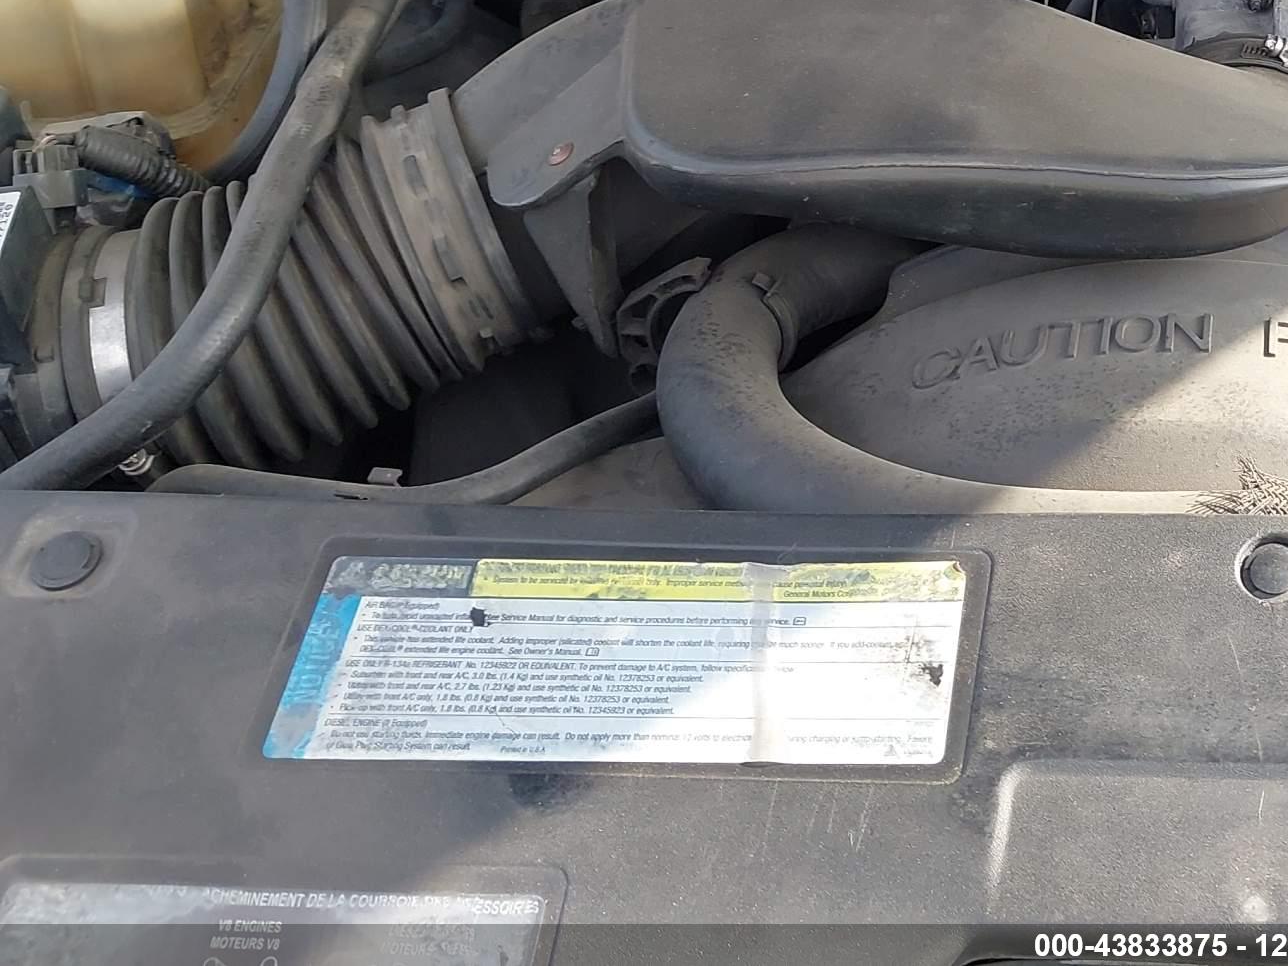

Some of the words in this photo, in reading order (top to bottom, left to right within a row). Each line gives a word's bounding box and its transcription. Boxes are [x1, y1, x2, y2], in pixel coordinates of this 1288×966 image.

[912, 313, 1215, 390] CAUTION
[784, 590, 810, 598] General
[811, 590, 835, 598] Motors
[567, 615, 602, 624] diagnostic
[646, 616, 684, 625] procedures
[710, 617, 748, 625] performing
[499, 637, 524, 645] Adding
[526, 637, 556, 645] improper
[558, 638, 592, 646] (silicated)
[718, 640, 750, 649] requiring
[451, 647, 476, 655] engine
[589, 663, 616, 671] prevent
[618, 663, 648, 671] damage
[671, 664, 698, 672] system,
[500, 673, 514, 681] (1.4
[516, 673, 528, 681] Kg)
[560, 673, 592, 682] synthetic
[666, 675, 704, 683] equivalent.
[503, 684, 515, 692] Kg)
[546, 685, 579, 693] synthetic
[654, 686, 690, 694] equivalent.
[464, 694, 479, 703] (0.8
[480, 695, 492, 703] Kg)
[524, 695, 556, 703] synthetic
[468, 705, 483, 713] (0.8
[528, 706, 561, 714] synthetic
[391, 720, 428, 728] Equipped)
[465, 732, 490, 740] engine
[590, 733, 610, 741] apply
[404, 742, 432, 751] System
[306, 894, 326, 909] DE
[328, 894, 346, 908] LA
[234, 920, 282, 933] ENGINES
[210, 936, 264, 950] MOTEURS
[266, 937, 280, 950] V8
